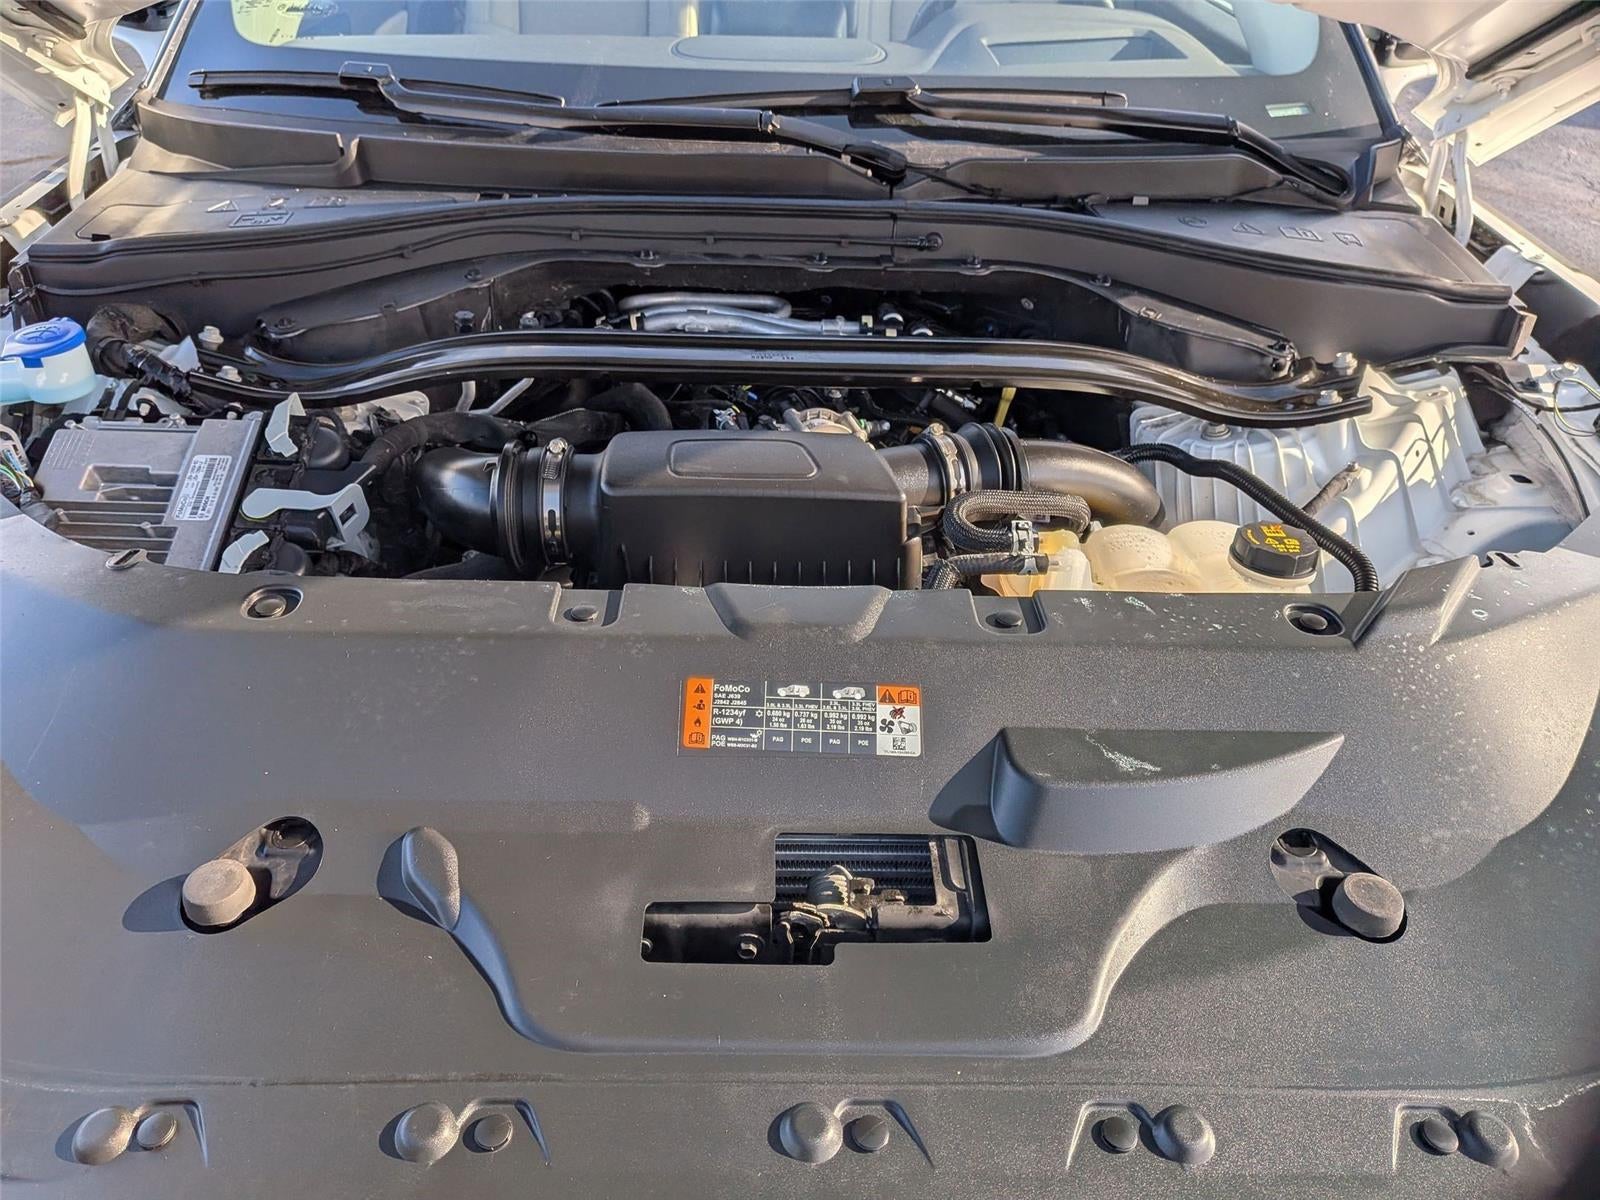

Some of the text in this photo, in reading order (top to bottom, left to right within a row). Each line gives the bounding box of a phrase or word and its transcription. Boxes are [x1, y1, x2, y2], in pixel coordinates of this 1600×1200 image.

[714, 684, 751, 693] FoMoCo
[713, 708, 747, 717] R-1234yf
[712, 717, 743, 727] (GWP 4)
[868, 714, 875, 722] kg
